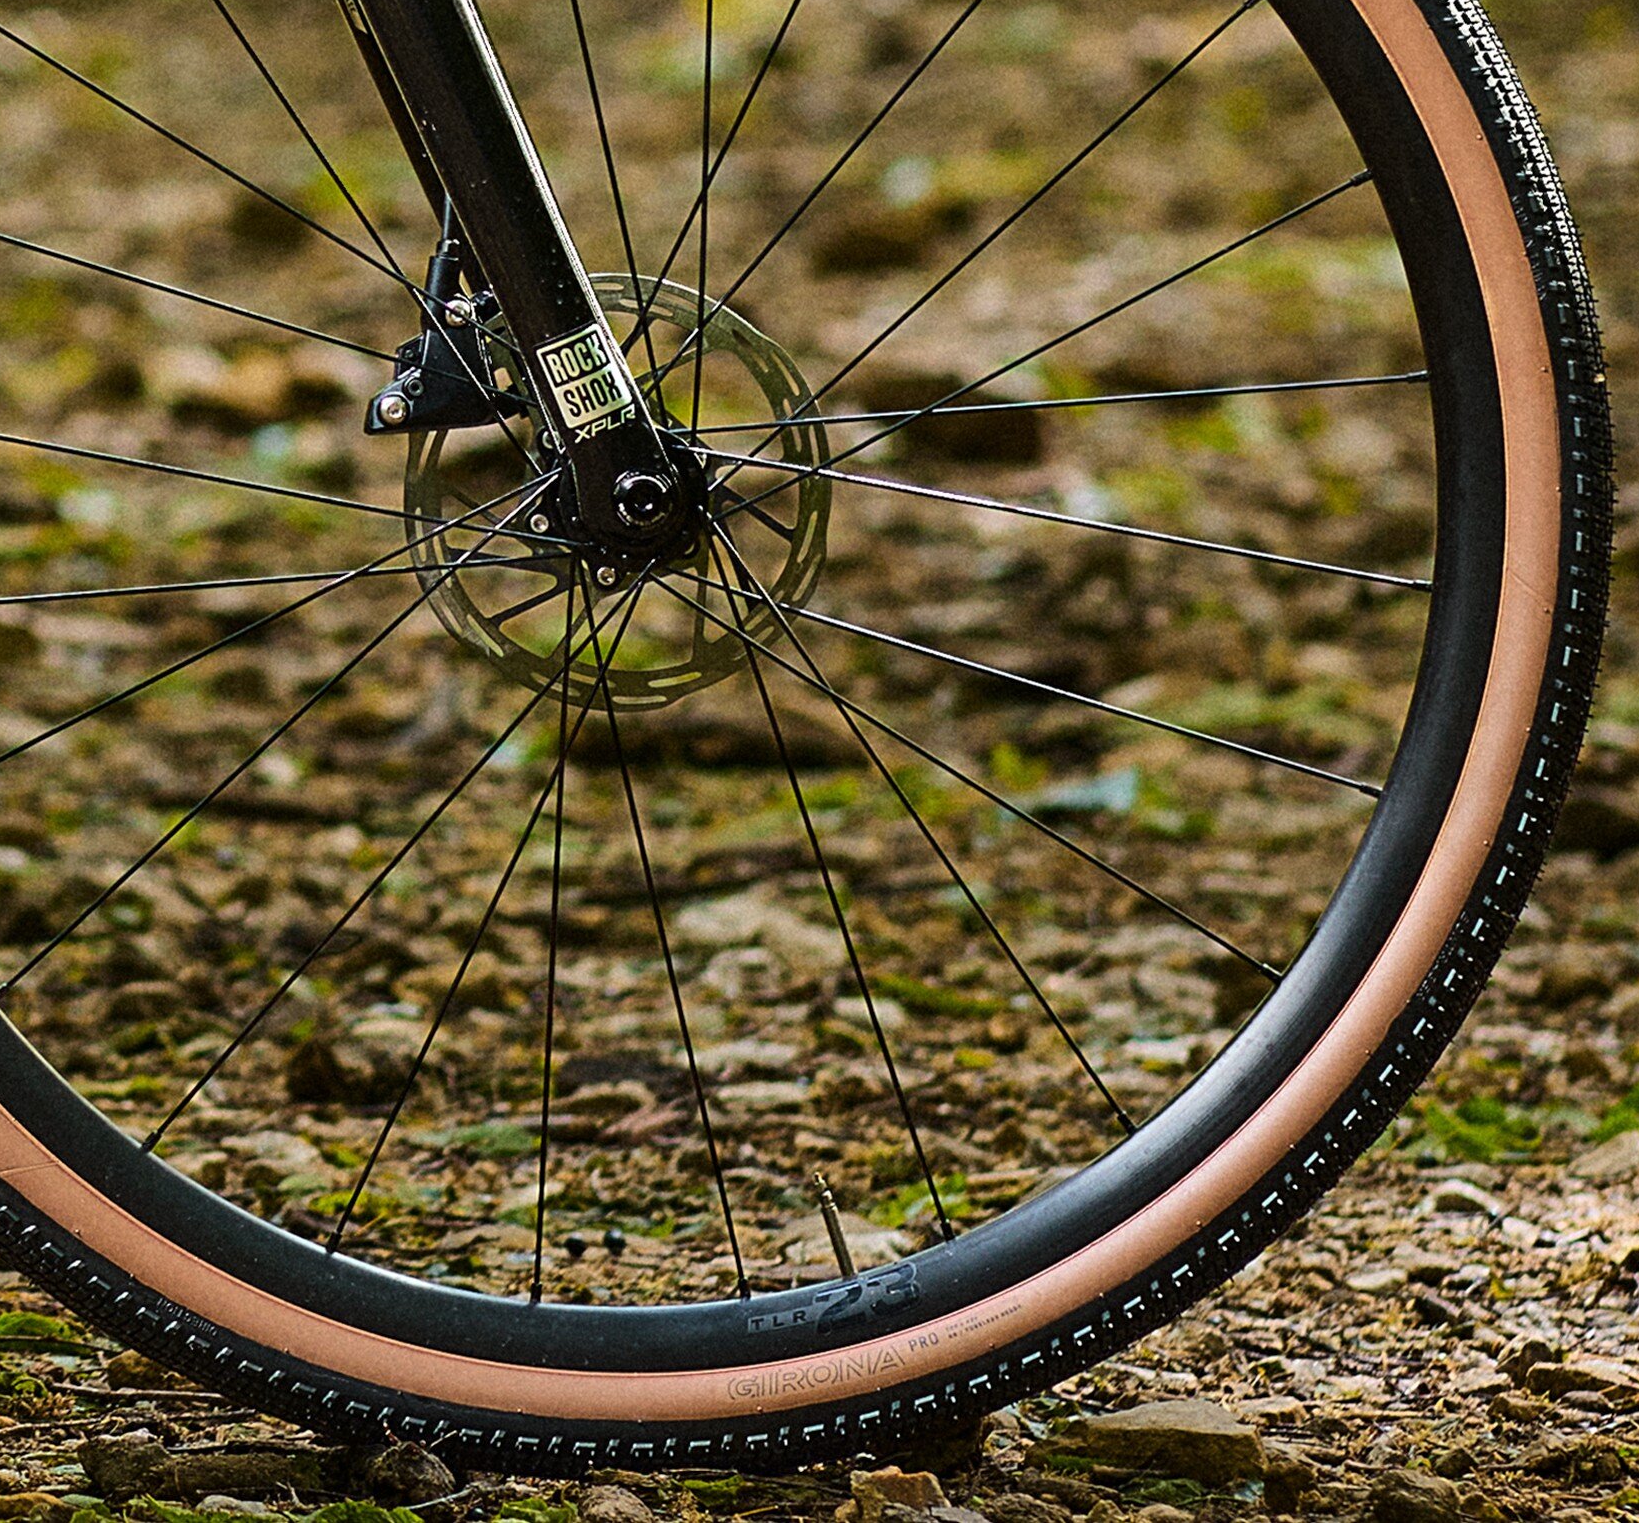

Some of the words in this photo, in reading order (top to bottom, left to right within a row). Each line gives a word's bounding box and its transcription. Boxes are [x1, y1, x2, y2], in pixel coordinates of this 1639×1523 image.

[545, 333, 607, 384] ROCK
[563, 371, 622, 418] SHOX
[574, 403, 636, 444] XPLR
[751, 1309, 807, 1332] TLR
[812, 1261, 923, 1336] 23
[727, 1344, 906, 1401] GIRONA
[908, 1331, 940, 1353] PRO
